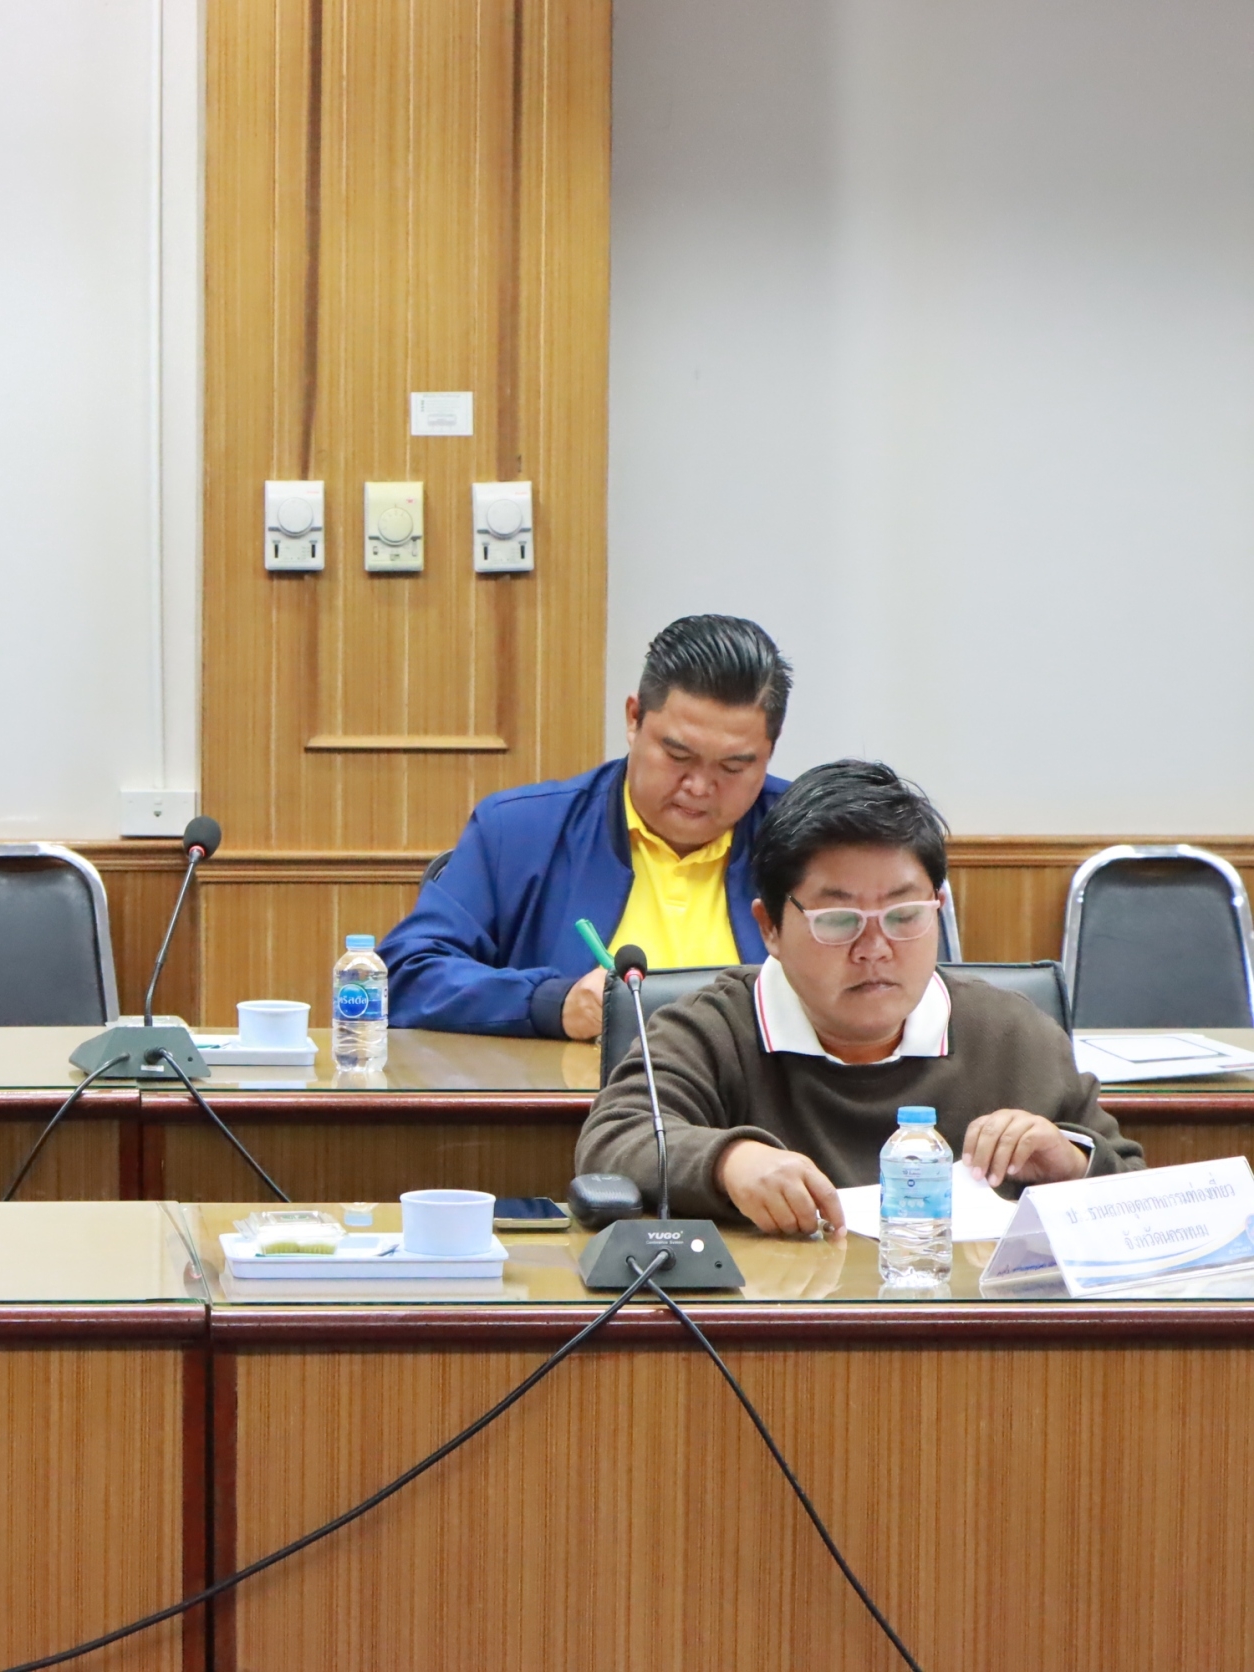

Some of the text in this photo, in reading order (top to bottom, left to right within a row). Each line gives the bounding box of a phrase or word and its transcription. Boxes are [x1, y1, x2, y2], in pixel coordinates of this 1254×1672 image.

[647, 1231, 682, 1240] YUGO
[1122, 1222, 1210, 1251] จังหวัดนครพนม
